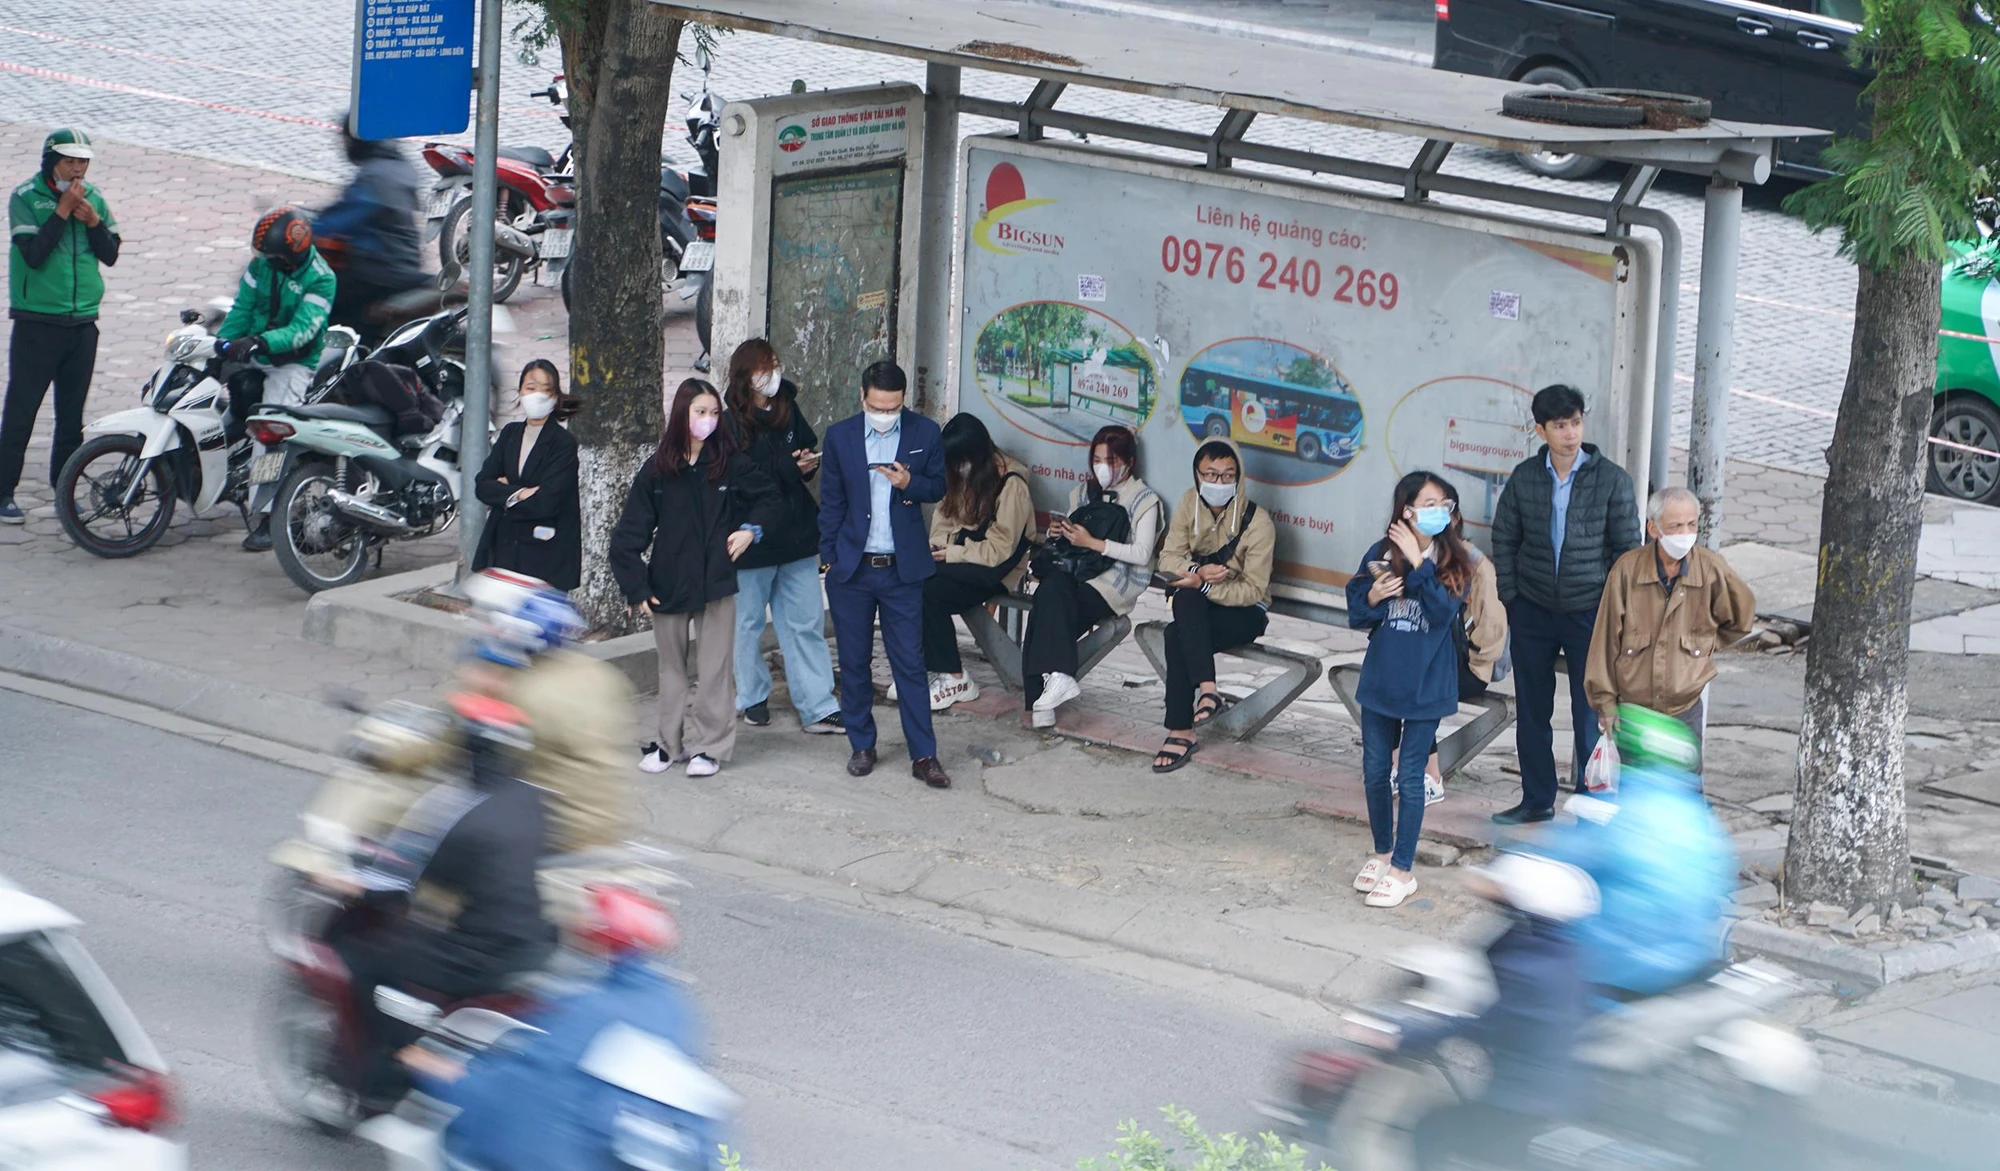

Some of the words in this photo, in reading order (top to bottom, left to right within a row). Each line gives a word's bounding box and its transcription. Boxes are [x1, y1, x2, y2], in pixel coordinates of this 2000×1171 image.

[822, 115, 836, 127] GIAO
[838, 112, 858, 124] THÔNG
[859, 110, 873, 123] VẬN
[33, 200, 57, 209] Grab
[997, 223, 1065, 249] BIGSUN
[1196, 204, 1234, 228] Liên
[1239, 211, 1262, 234] hệ
[1266, 217, 1322, 249] quảng
[1328, 227, 1368, 251] cáo:
[1161, 235, 1245, 285] 0976
[1257, 251, 1321, 298] 240
[1334, 264, 1399, 311] 269
[1096, 382, 1110, 395] 240
[1113, 384, 1129, 398] 269
[1449, 439, 1524, 459] bigsungroup.vn
[1031, 463, 1051, 476] cáo
[1054, 467, 1075, 480] nhà
[1078, 471, 1095, 482] ch
[1293, 515, 1306, 527] xe
[1309, 517, 1334, 534] buýt
